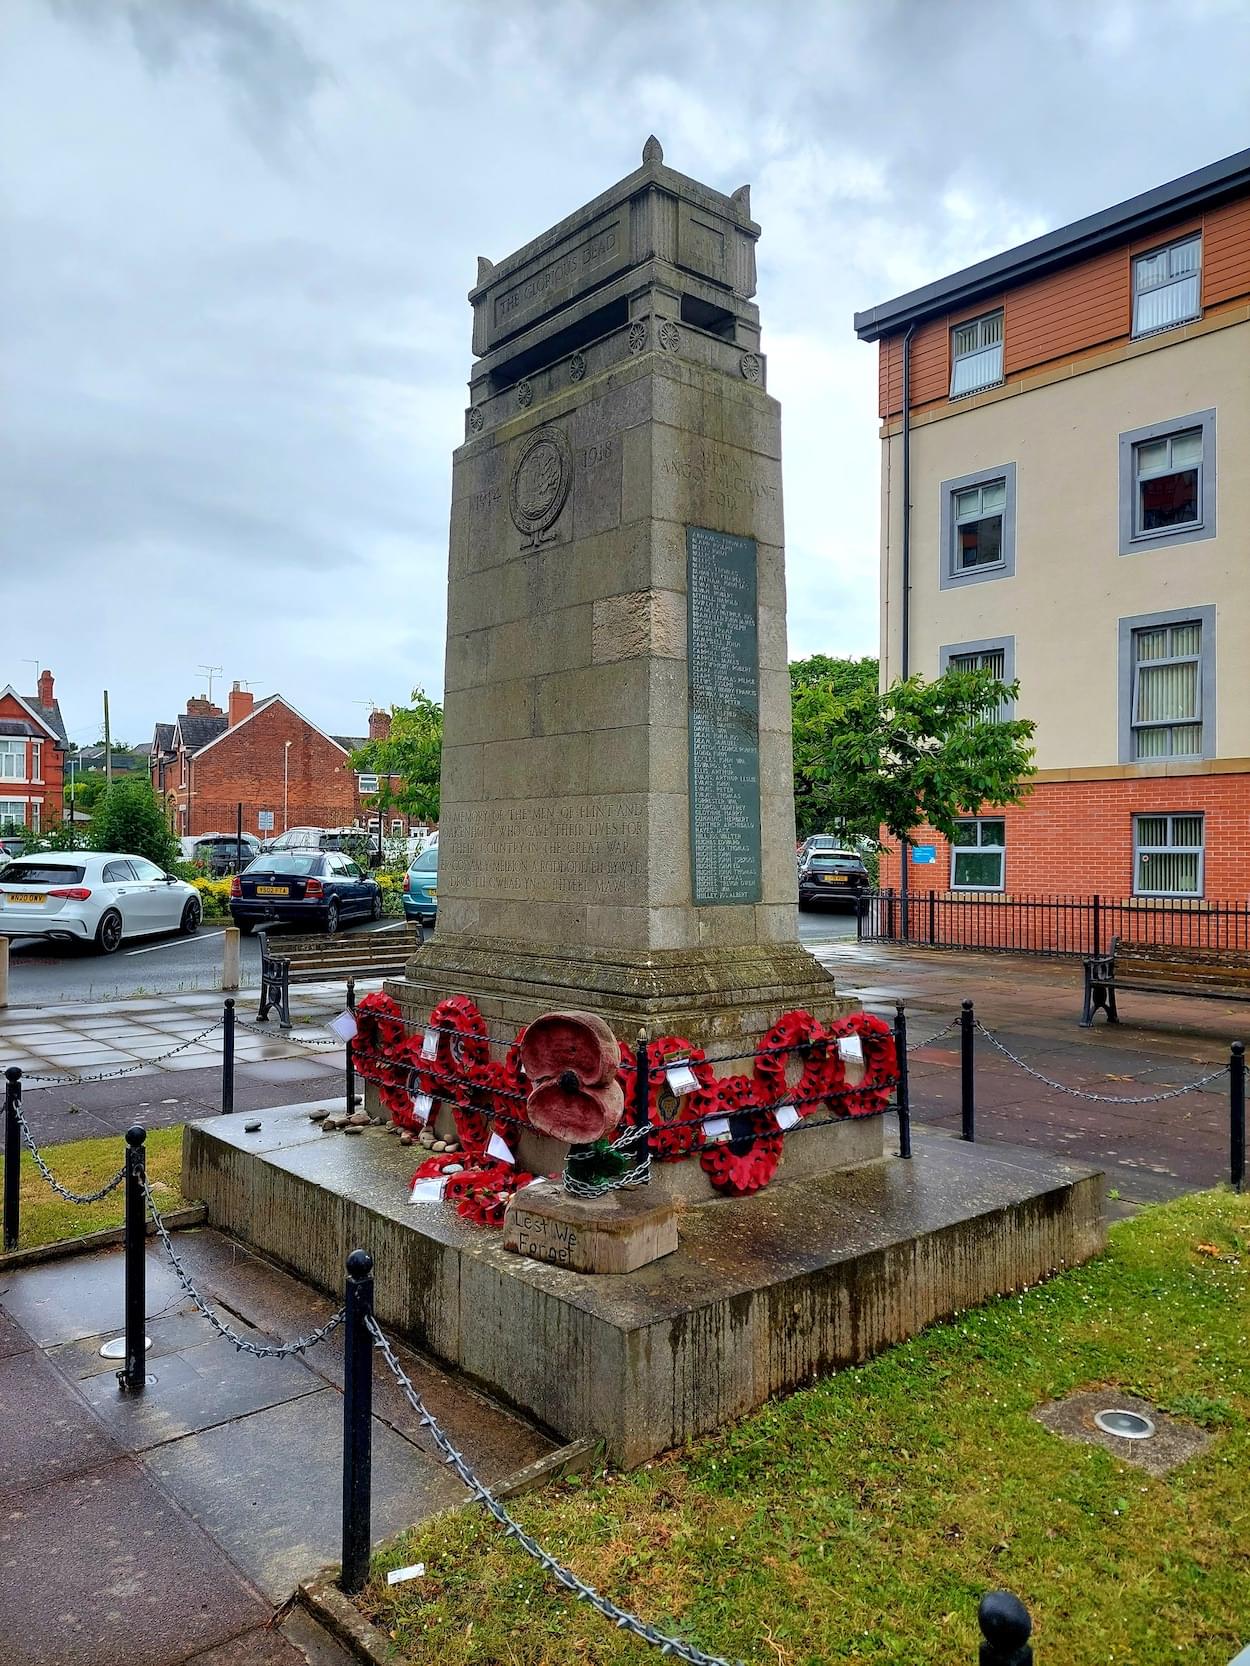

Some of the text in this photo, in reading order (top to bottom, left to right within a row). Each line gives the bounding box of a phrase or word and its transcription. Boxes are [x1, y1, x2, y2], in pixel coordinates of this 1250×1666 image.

[500, 233, 617, 315] THE GLORIOUS DEAD
[583, 440, 612, 468] 1918
[476, 487, 502, 511] 1914
[453, 808, 488, 823] MEMORY
[493, 808, 504, 821] OF
[508, 807, 528, 821] THE
[533, 806, 554, 820] MEN
[560, 806, 573, 819] OF
[580, 804, 614, 818] FLINT
[617, 803, 643, 817] AND
[499, 824, 521, 837] WHO
[525, 824, 550, 837] GAVE
[554, 823, 584, 837] THEIR
[588, 822, 618, 836] LIVES
[622, 821, 643, 835] FOR
[451, 841, 630, 855] THEIR COUNTRY IN THE GREAT WAR
[514, 1210, 577, 1247] Lest We
[518, 1232, 575, 1264] Forget
